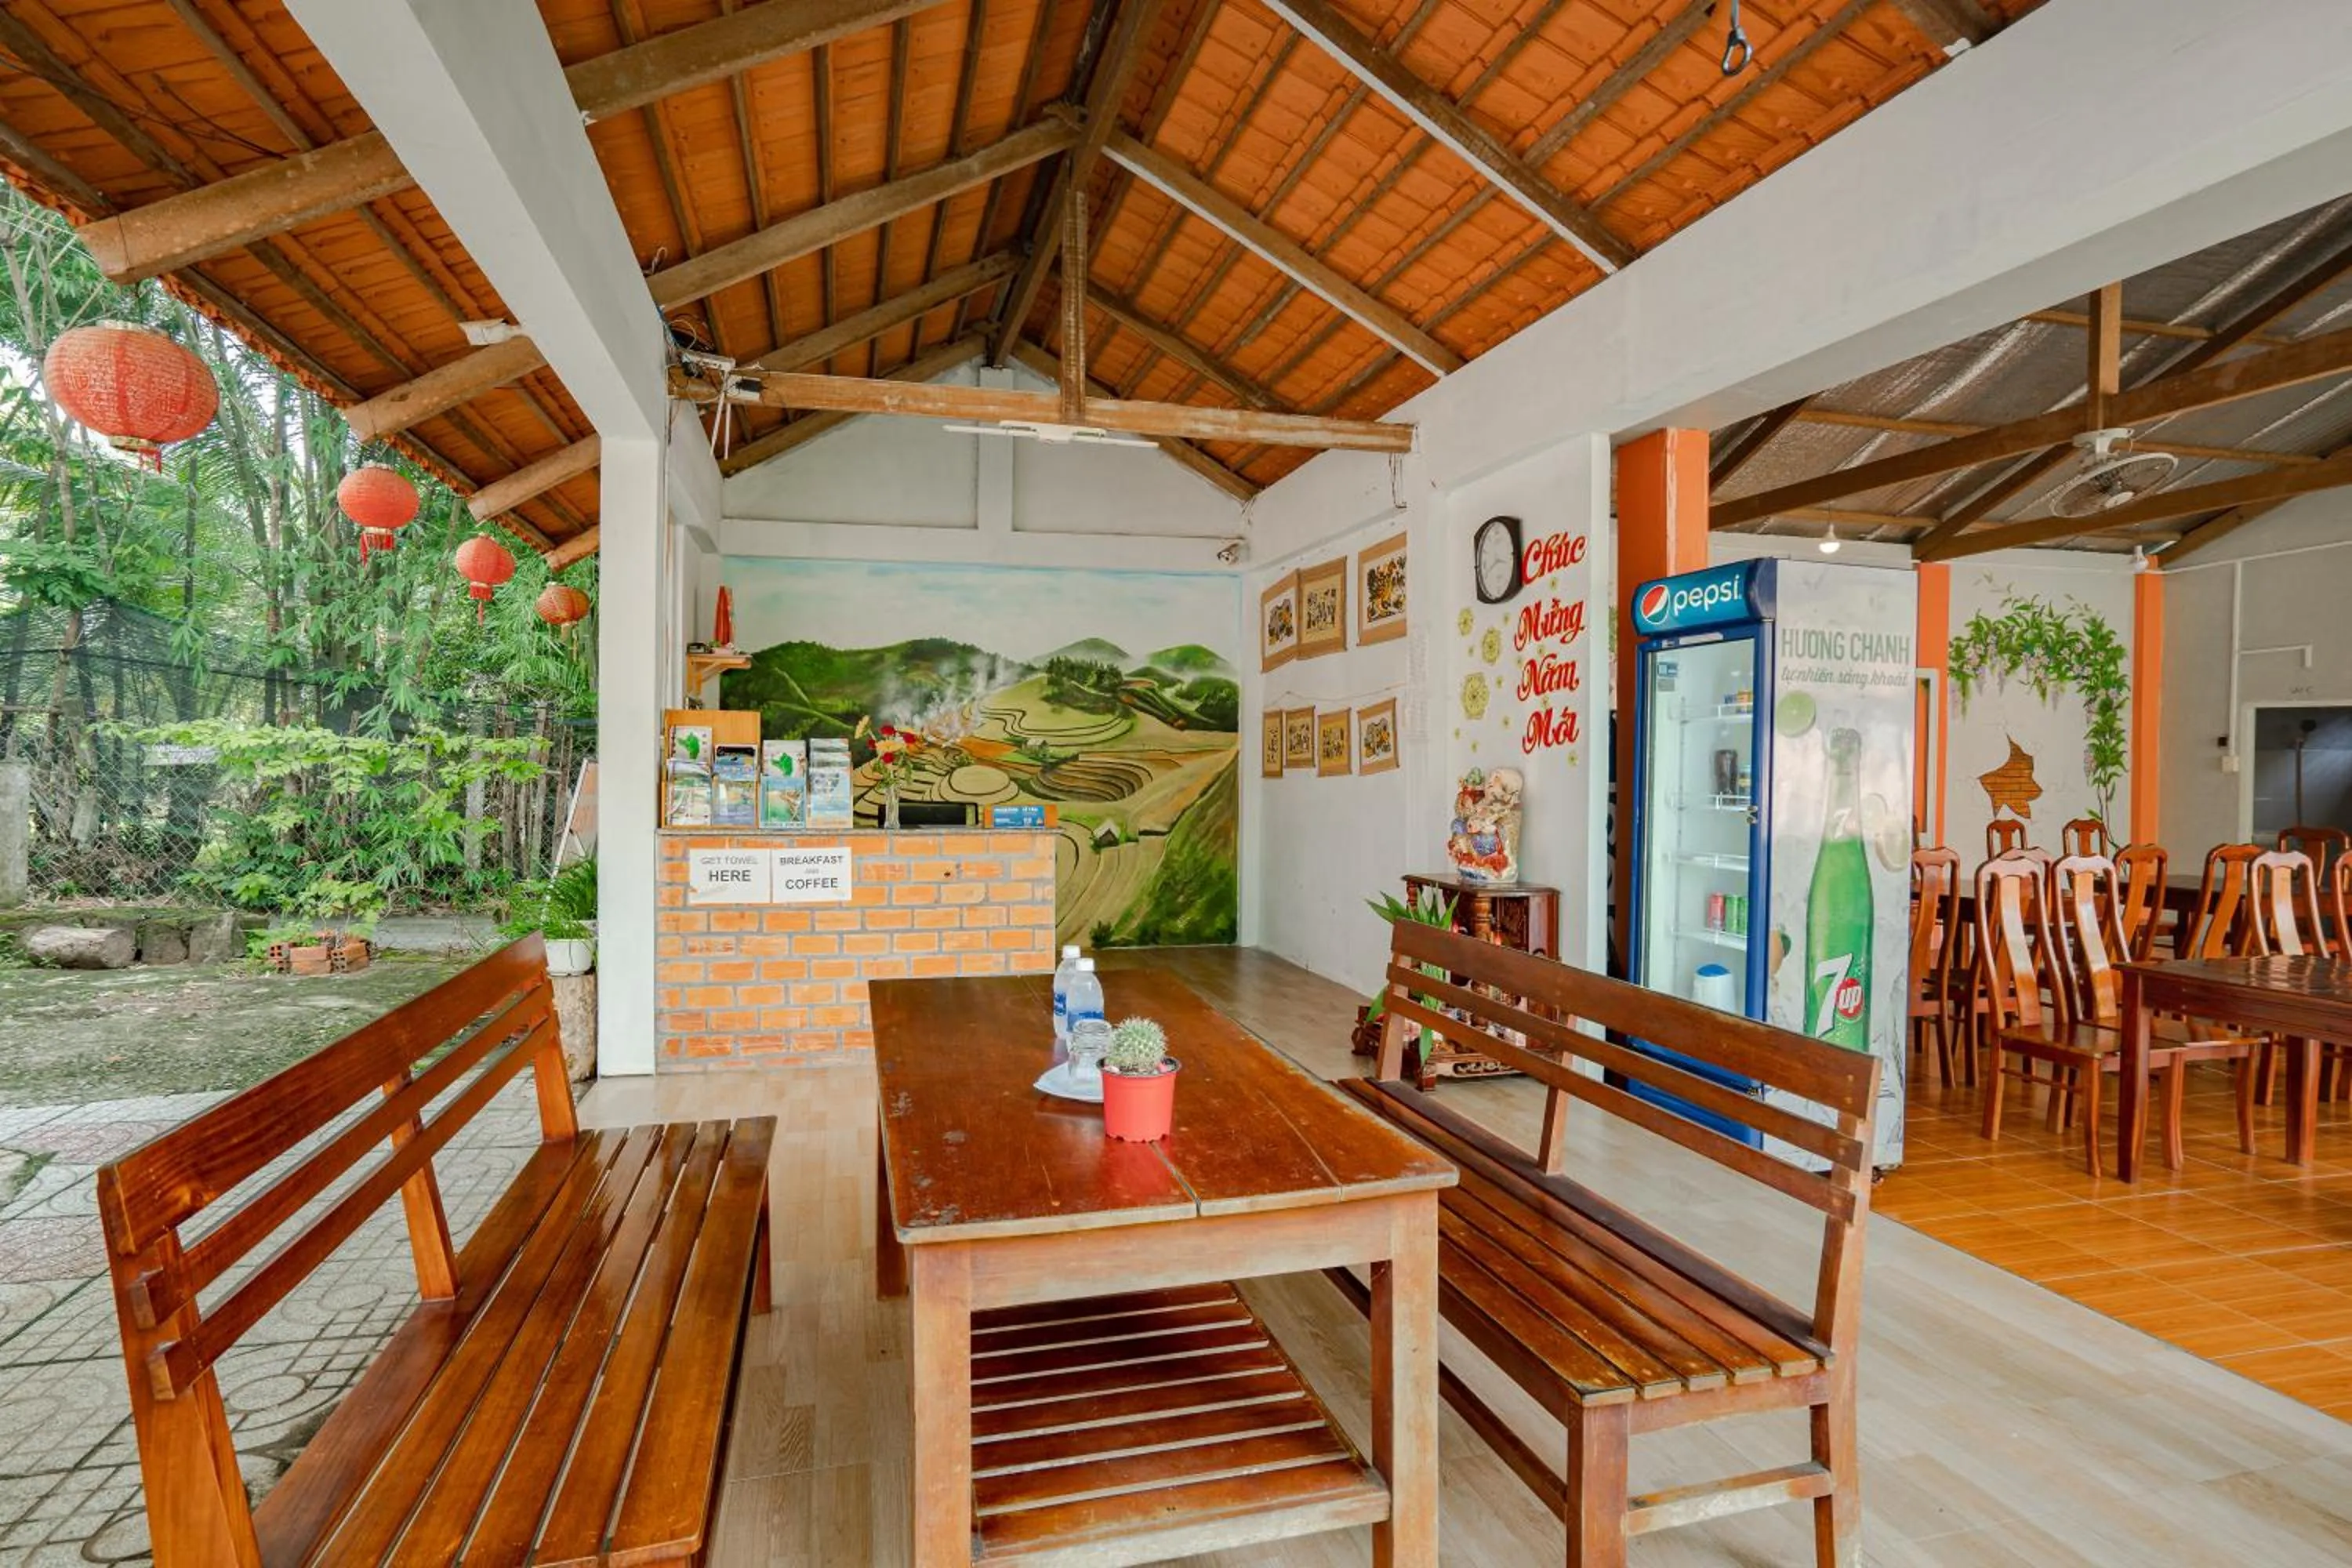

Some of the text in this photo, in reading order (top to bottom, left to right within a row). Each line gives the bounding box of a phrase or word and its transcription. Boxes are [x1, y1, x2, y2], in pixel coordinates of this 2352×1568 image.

[1523, 532, 1586, 585] Chúc
[1674, 574, 1740, 616] pepsi
[1514, 598, 1585, 652] Mừng
[1850, 633, 1910, 665] CHANH
[1517, 653, 1580, 701] Năm
[1523, 706, 1580, 754] Mới
[709, 869, 751, 882] HERE
[779, 855, 844, 866] BREAKFAST
[785, 877, 838, 890] COFFEE
